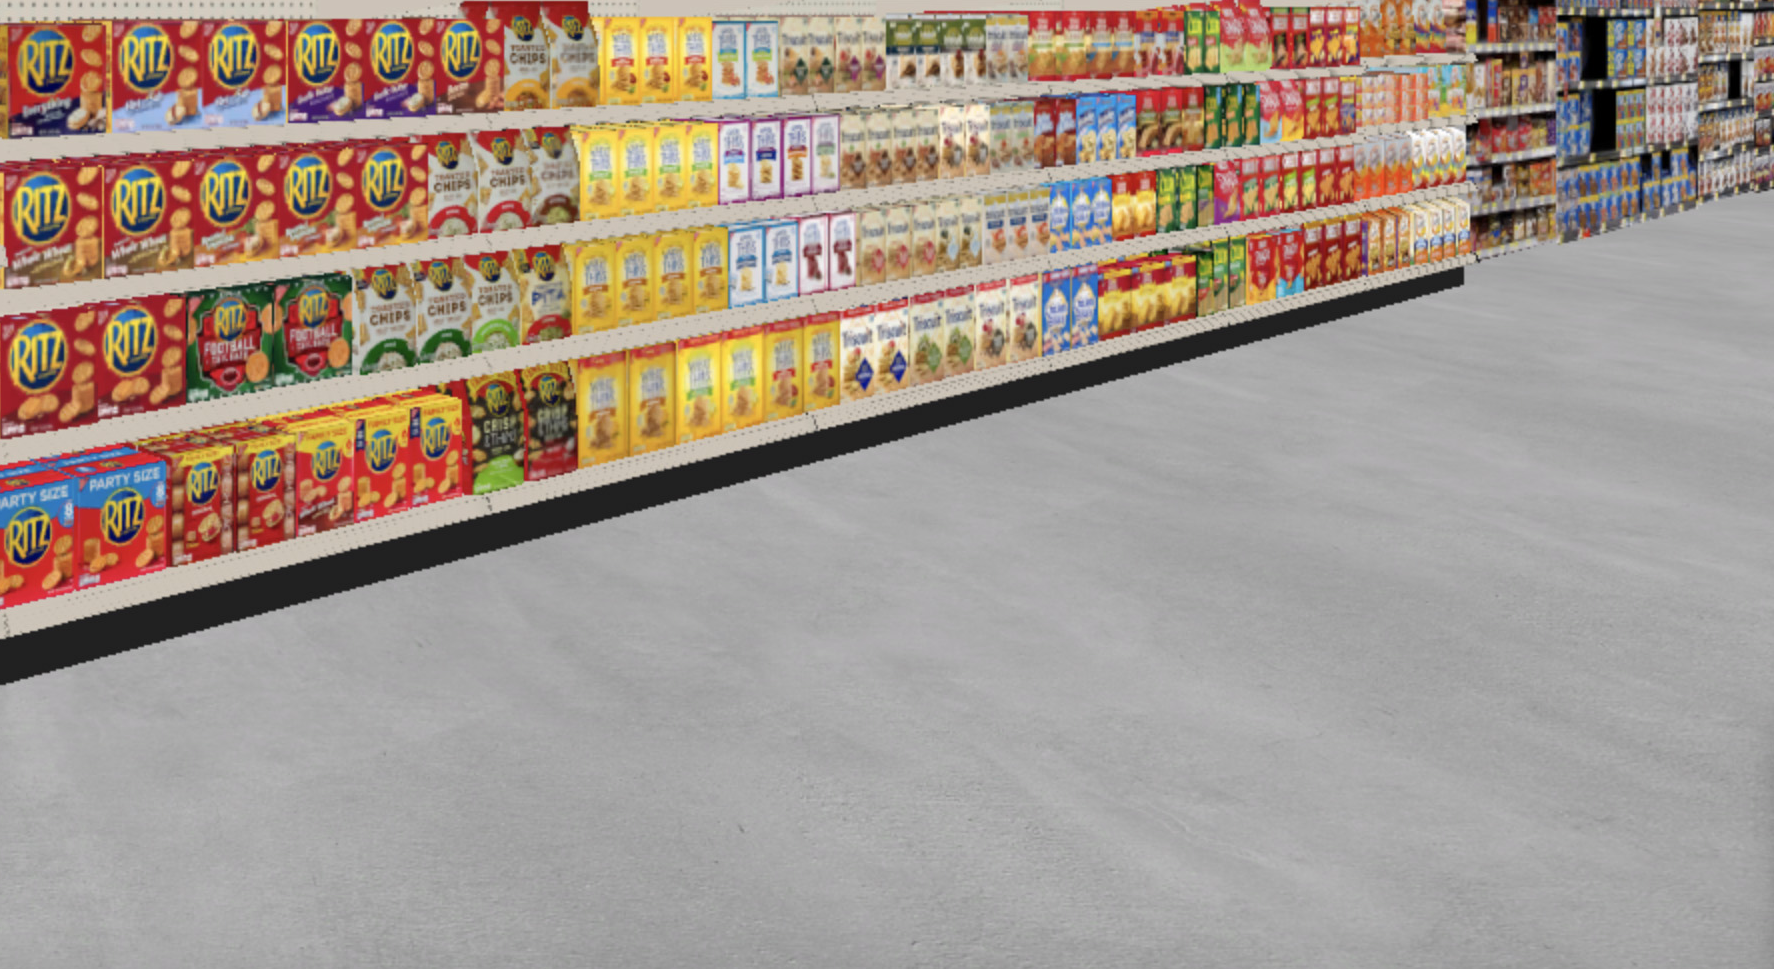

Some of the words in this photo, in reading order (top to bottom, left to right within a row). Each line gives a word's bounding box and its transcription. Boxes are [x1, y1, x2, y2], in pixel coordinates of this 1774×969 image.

[24, 40, 73, 86] RITZ
[122, 34, 169, 82] RITZ
[210, 34, 256, 81] RITZ
[297, 32, 336, 76] RITZ
[373, 32, 411, 74] RITZ
[443, 32, 479, 71] RITZ
[510, 52, 546, 65] CHIPS
[115, 177, 163, 226] RITZ
[203, 170, 248, 218] RITZ
[289, 162, 328, 209] RITZ
[366, 157, 404, 202] RITZ
[16, 184, 67, 235] RITZ
[369, 311, 411, 327] CHIPS
[427, 301, 467, 318] CHIPS
[478, 292, 513, 306] CHIPS
[12, 330, 64, 383] RITZ
[106, 317, 153, 365] RITZ
[204, 338, 256, 355] FOOTBALL
[289, 325, 338, 345] FOOTBALL
[39, 485, 69, 503] SIZE
[89, 473, 132, 492] PARTY
[134, 466, 161, 484] SIZE
[6, 516, 51, 564] RITZ
[102, 496, 143, 542] RITZ
